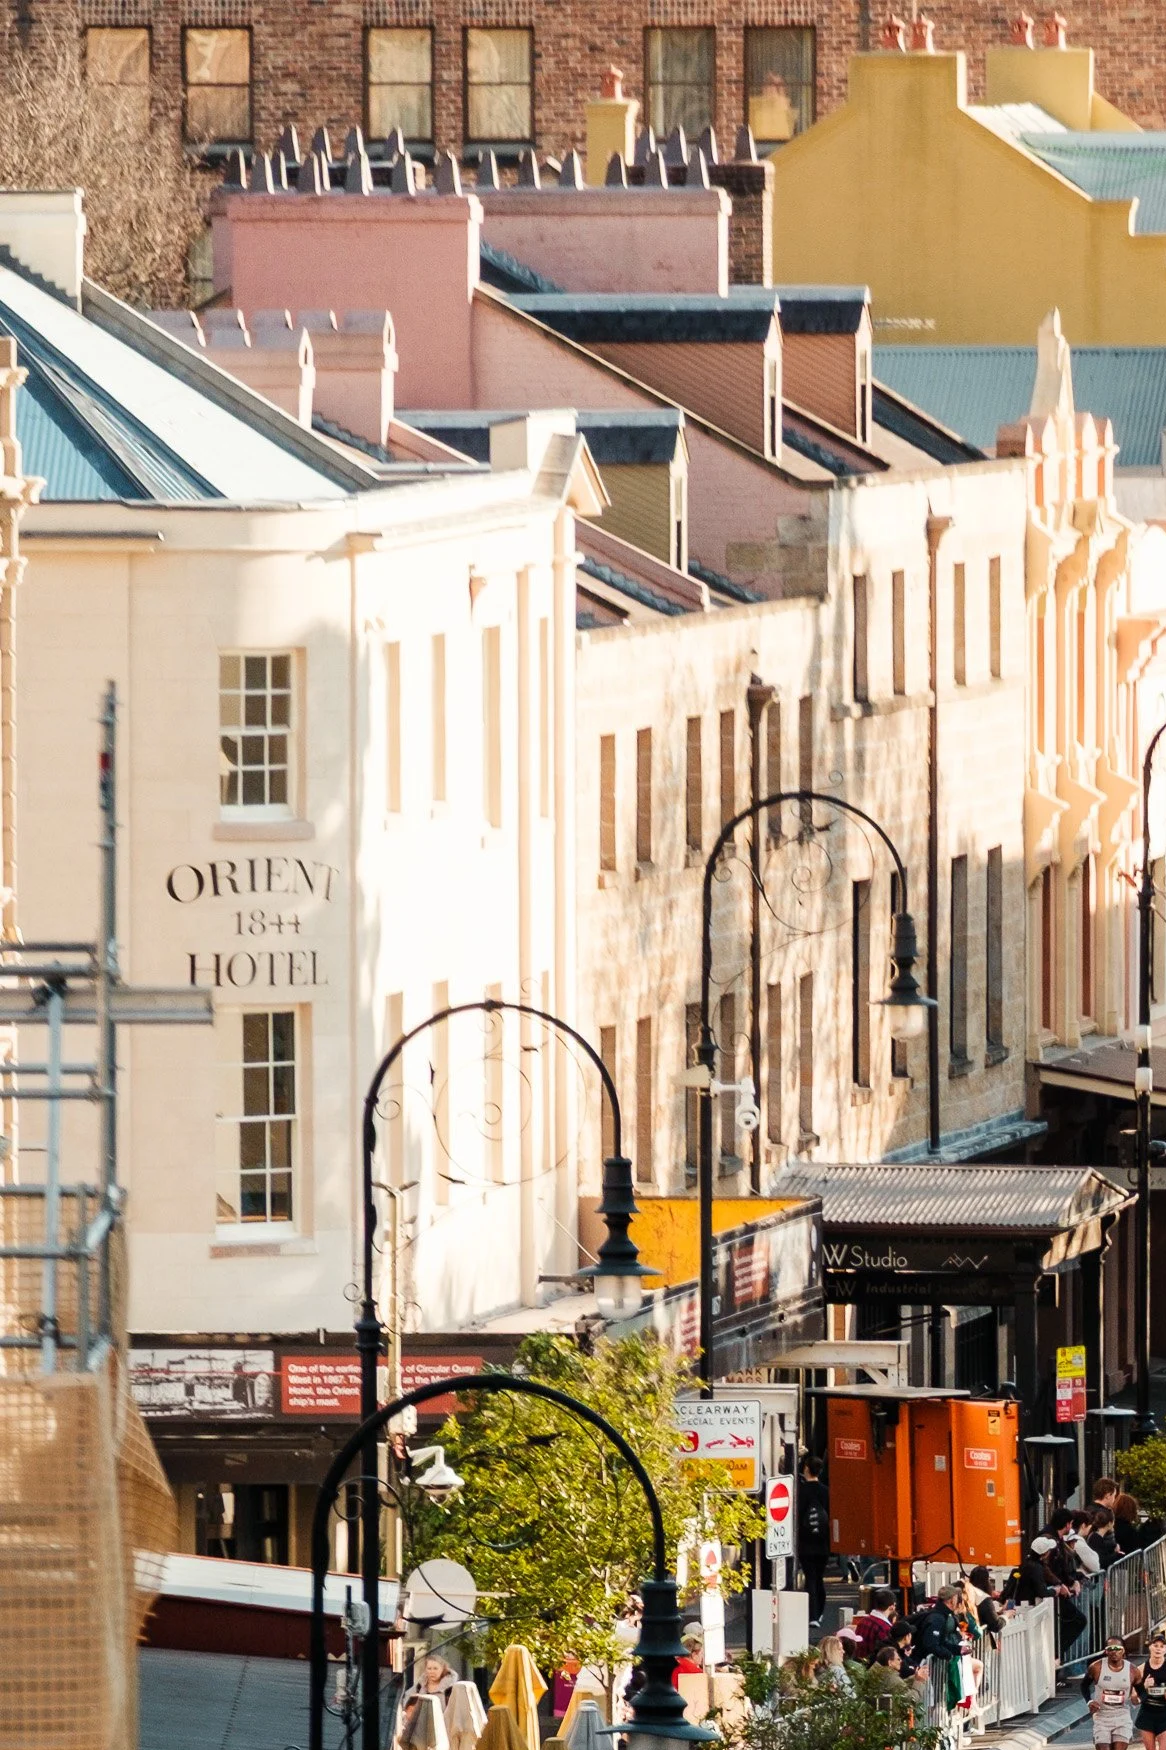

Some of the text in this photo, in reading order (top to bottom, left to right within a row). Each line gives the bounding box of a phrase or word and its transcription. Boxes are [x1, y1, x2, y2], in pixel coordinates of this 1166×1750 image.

[166, 856, 340, 904] ORIENT
[234, 908, 302, 936] 1844
[185, 950, 329, 988] HOTEL
[850, 1245, 908, 1268] Studio
[288, 1363, 308, 1374] One
[308, 1364, 319, 1374] of
[319, 1364, 335, 1374] the
[405, 1363, 476, 1375] of Circular Quay
[288, 1374, 312, 1384] West
[312, 1374, 322, 1384] in
[316, 1386, 332, 1396] the
[332, 1385, 361, 1396] Orient
[680, 1405, 750, 1416] CLEARWAY
[719, 1417, 756, 1425] EVENTS
[773, 1526, 786, 1538] NO
[769, 1540, 790, 1553] ENTRY
